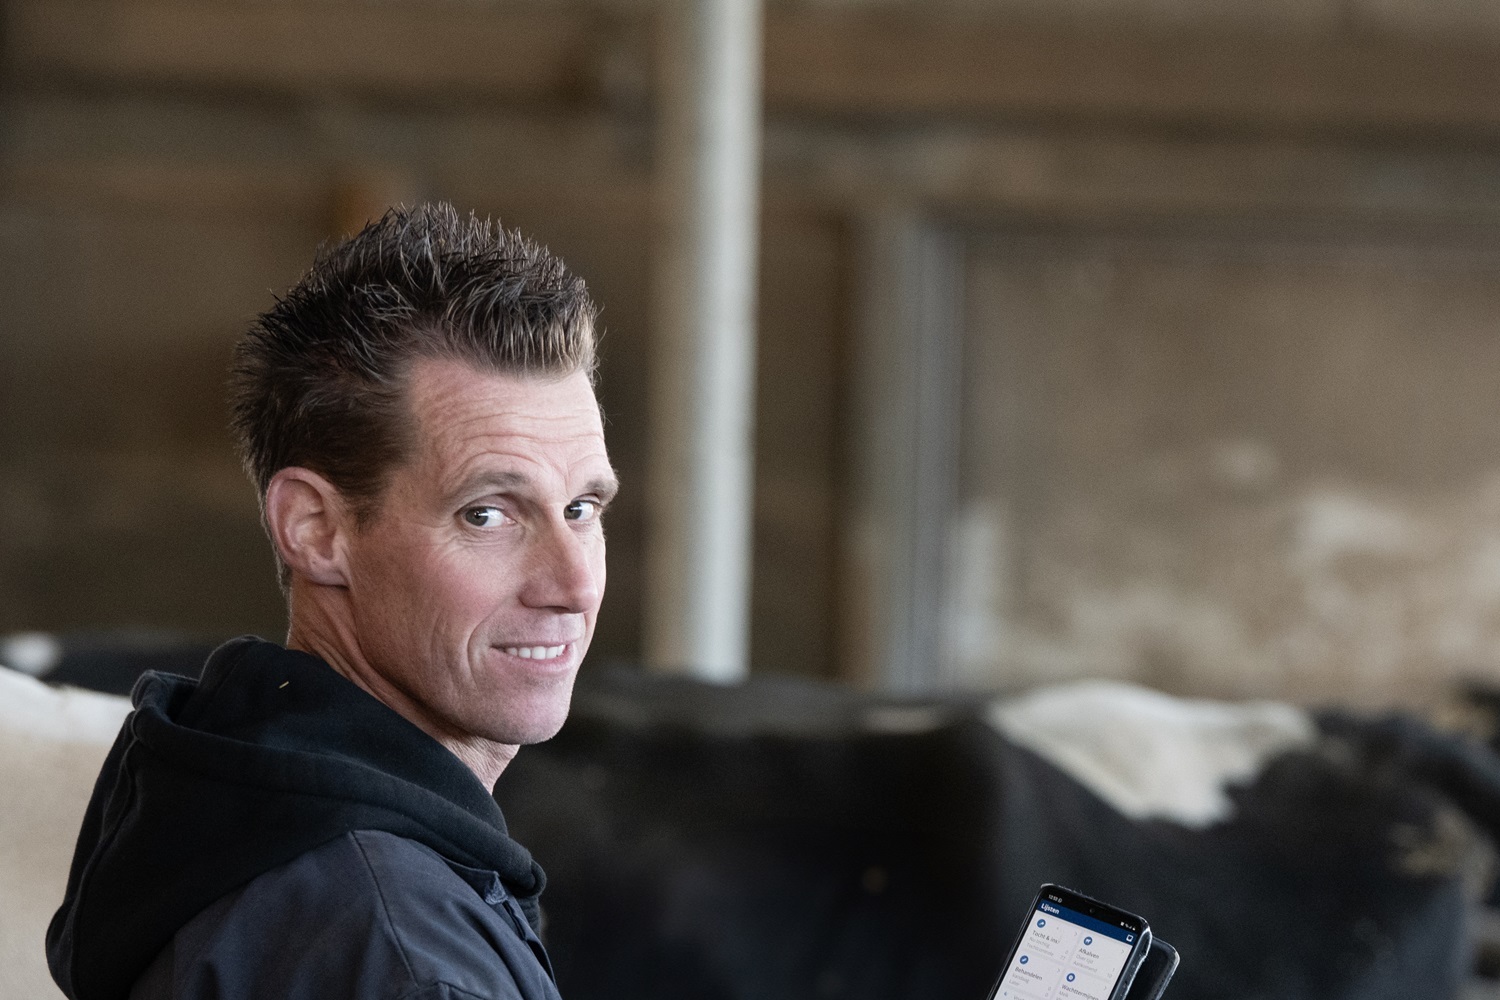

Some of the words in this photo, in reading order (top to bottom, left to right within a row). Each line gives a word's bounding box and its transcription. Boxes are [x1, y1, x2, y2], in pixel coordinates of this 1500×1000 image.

[1041, 903, 1059, 914] Lijsten
[1033, 930, 1046, 938] Tocht
[1079, 948, 1099, 958] Afkalven
[1015, 967, 1043, 980] Behandelen
